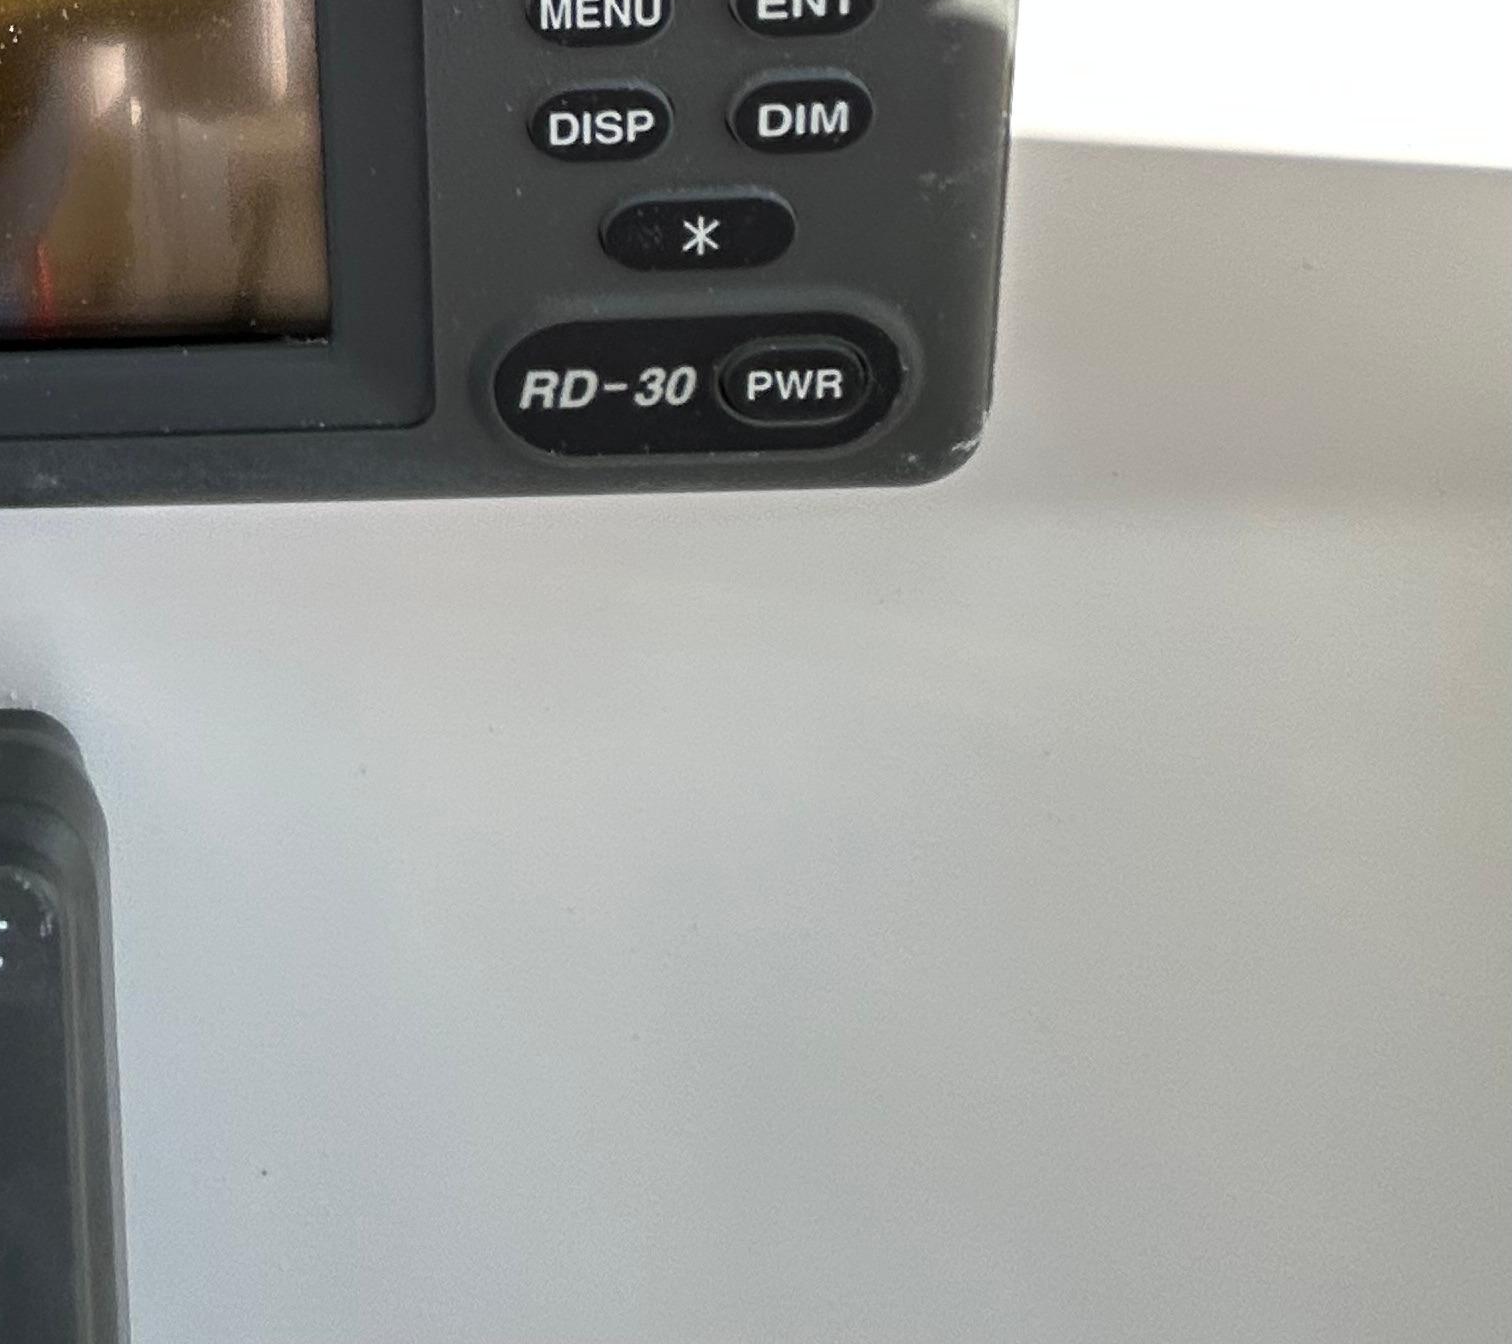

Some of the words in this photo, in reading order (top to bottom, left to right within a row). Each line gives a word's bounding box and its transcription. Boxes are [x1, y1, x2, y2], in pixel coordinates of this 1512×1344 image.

[547, 108, 656, 148] DISP
[757, 100, 850, 139] DIM
[518, 365, 697, 411] RD-30
[746, 368, 844, 402] PWR
